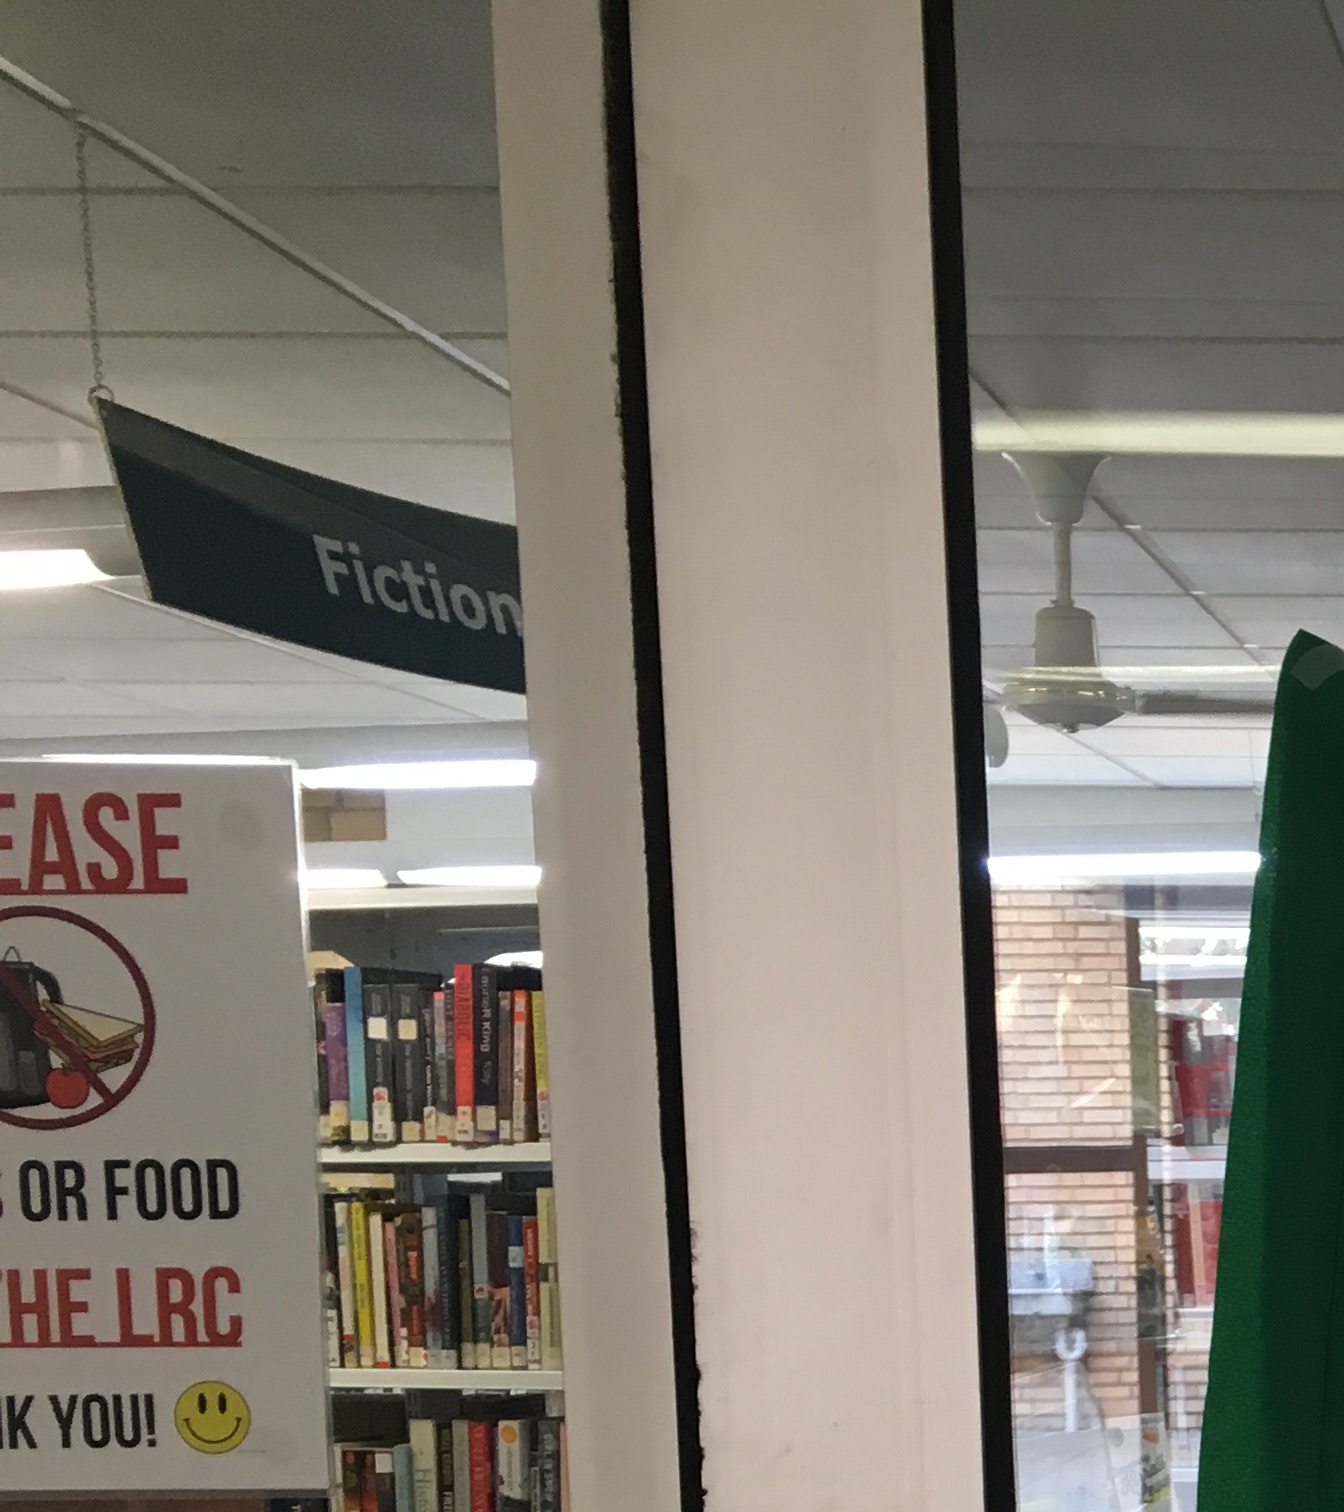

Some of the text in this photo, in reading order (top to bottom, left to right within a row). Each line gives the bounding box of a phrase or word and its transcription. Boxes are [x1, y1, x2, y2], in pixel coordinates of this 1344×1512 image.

[312, 534, 523, 637] Fiction
[19, 1160, 88, 1221] OR
[104, 1159, 240, 1221] FOOD
[0, 1266, 242, 1348] HE LRC
[48, 1393, 157, 1449] YOU!
